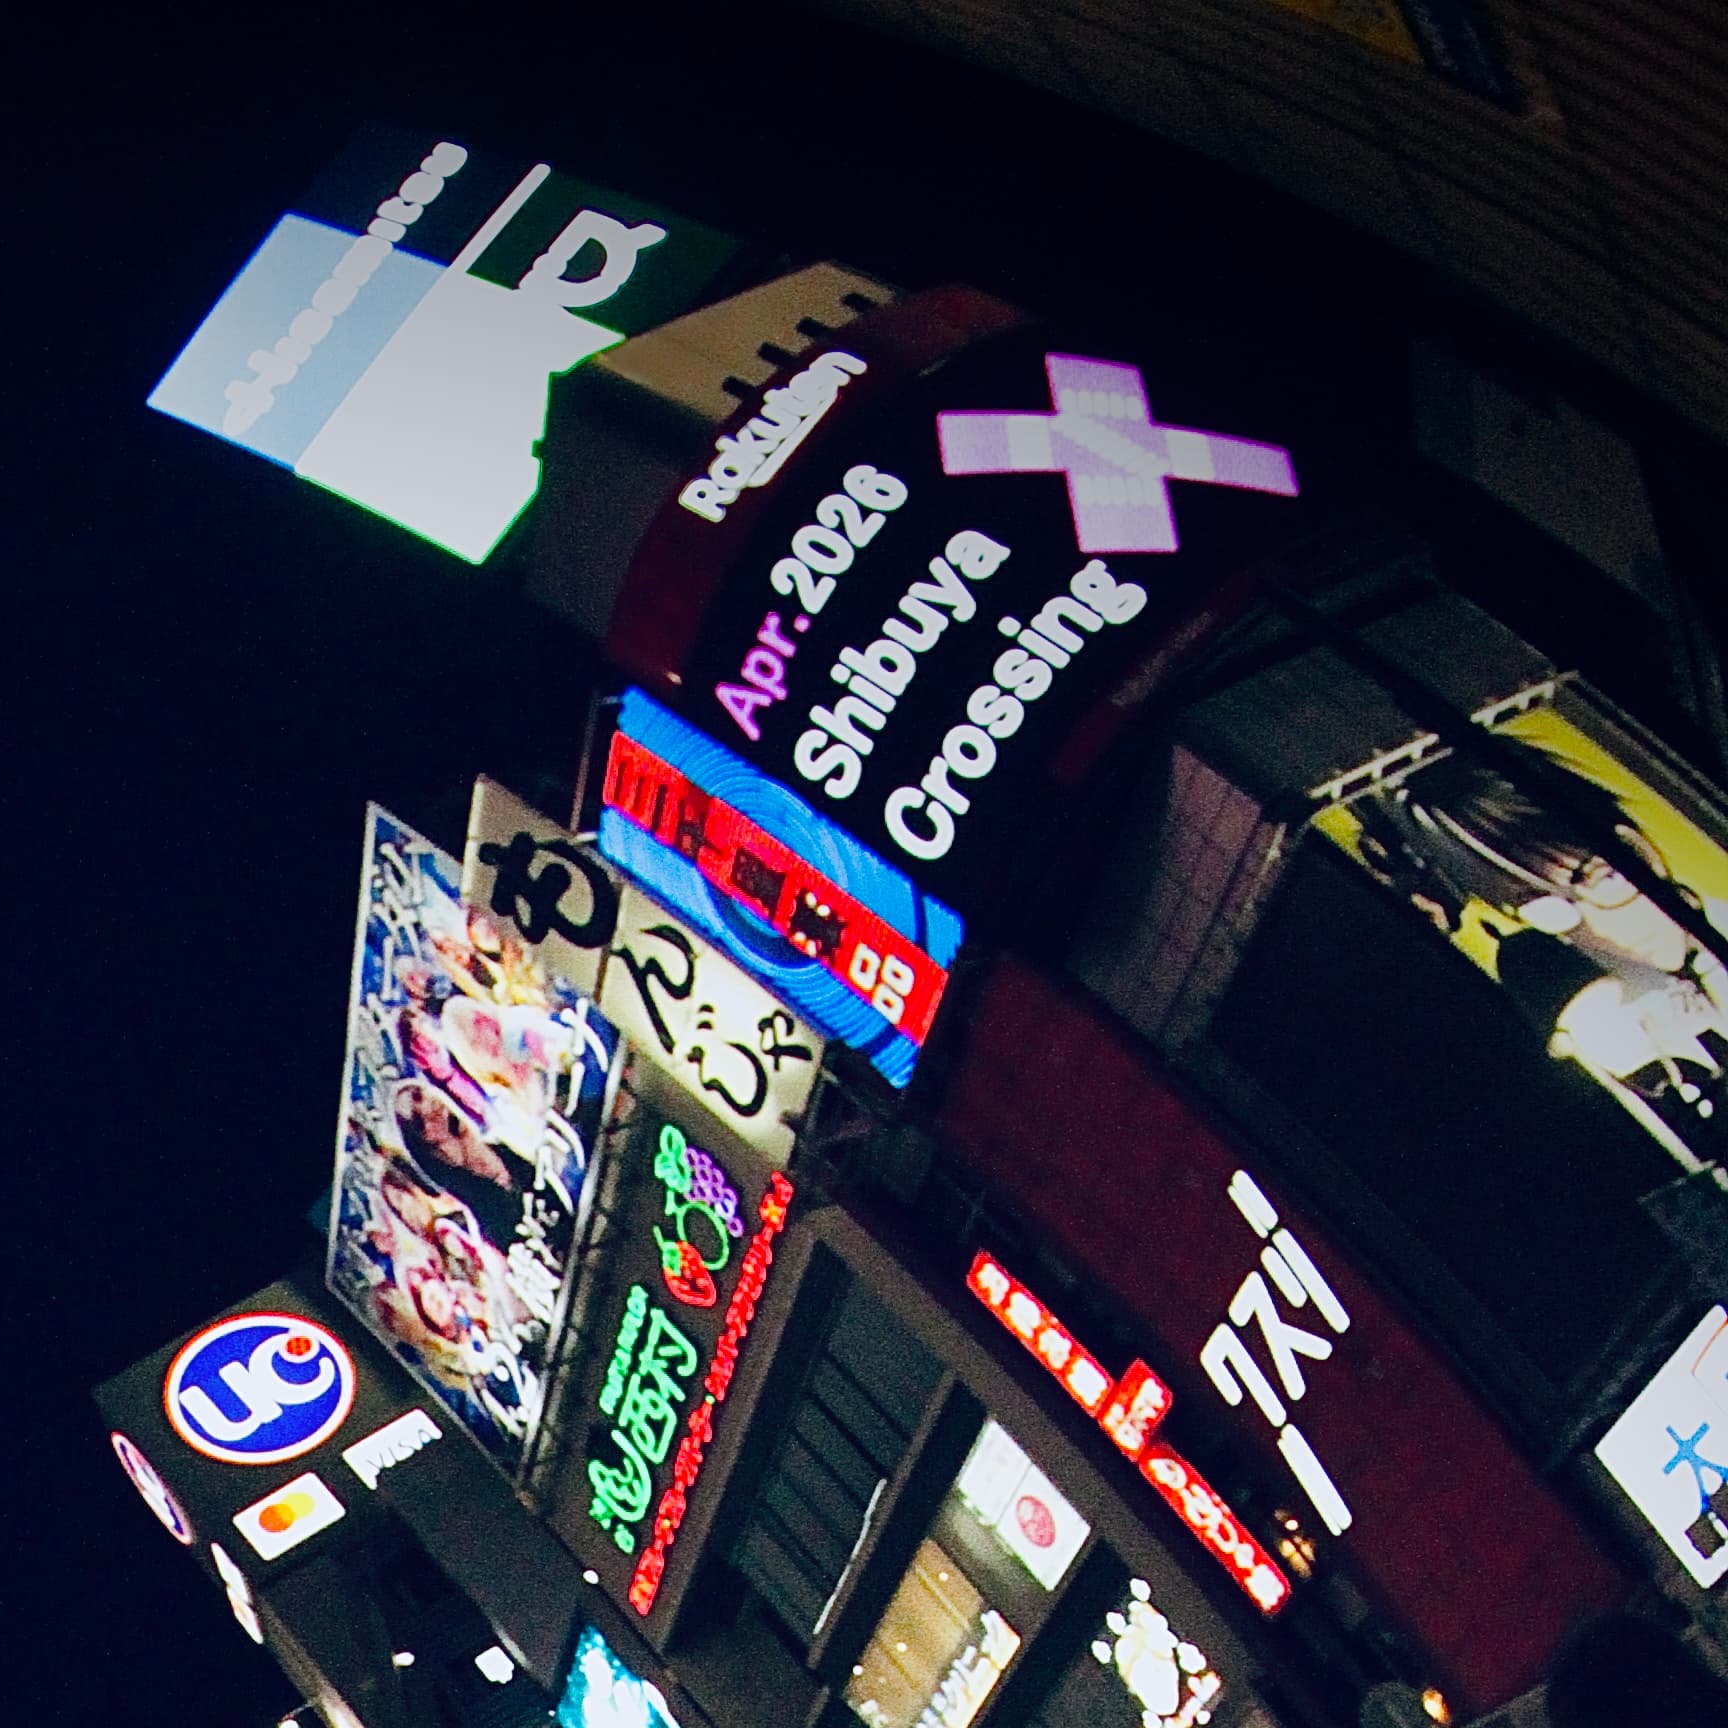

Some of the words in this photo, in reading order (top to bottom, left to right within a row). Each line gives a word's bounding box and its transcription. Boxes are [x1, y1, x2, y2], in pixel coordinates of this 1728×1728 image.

[679, 352, 867, 521] Rakuten
[771, 465, 910, 614] 2026
[794, 529, 1012, 799] Shibuya
[884, 559, 1149, 861] Crossing
[479, 832, 812, 1117] もんじゃ
[1201, 1228, 1351, 1426] クスリ
